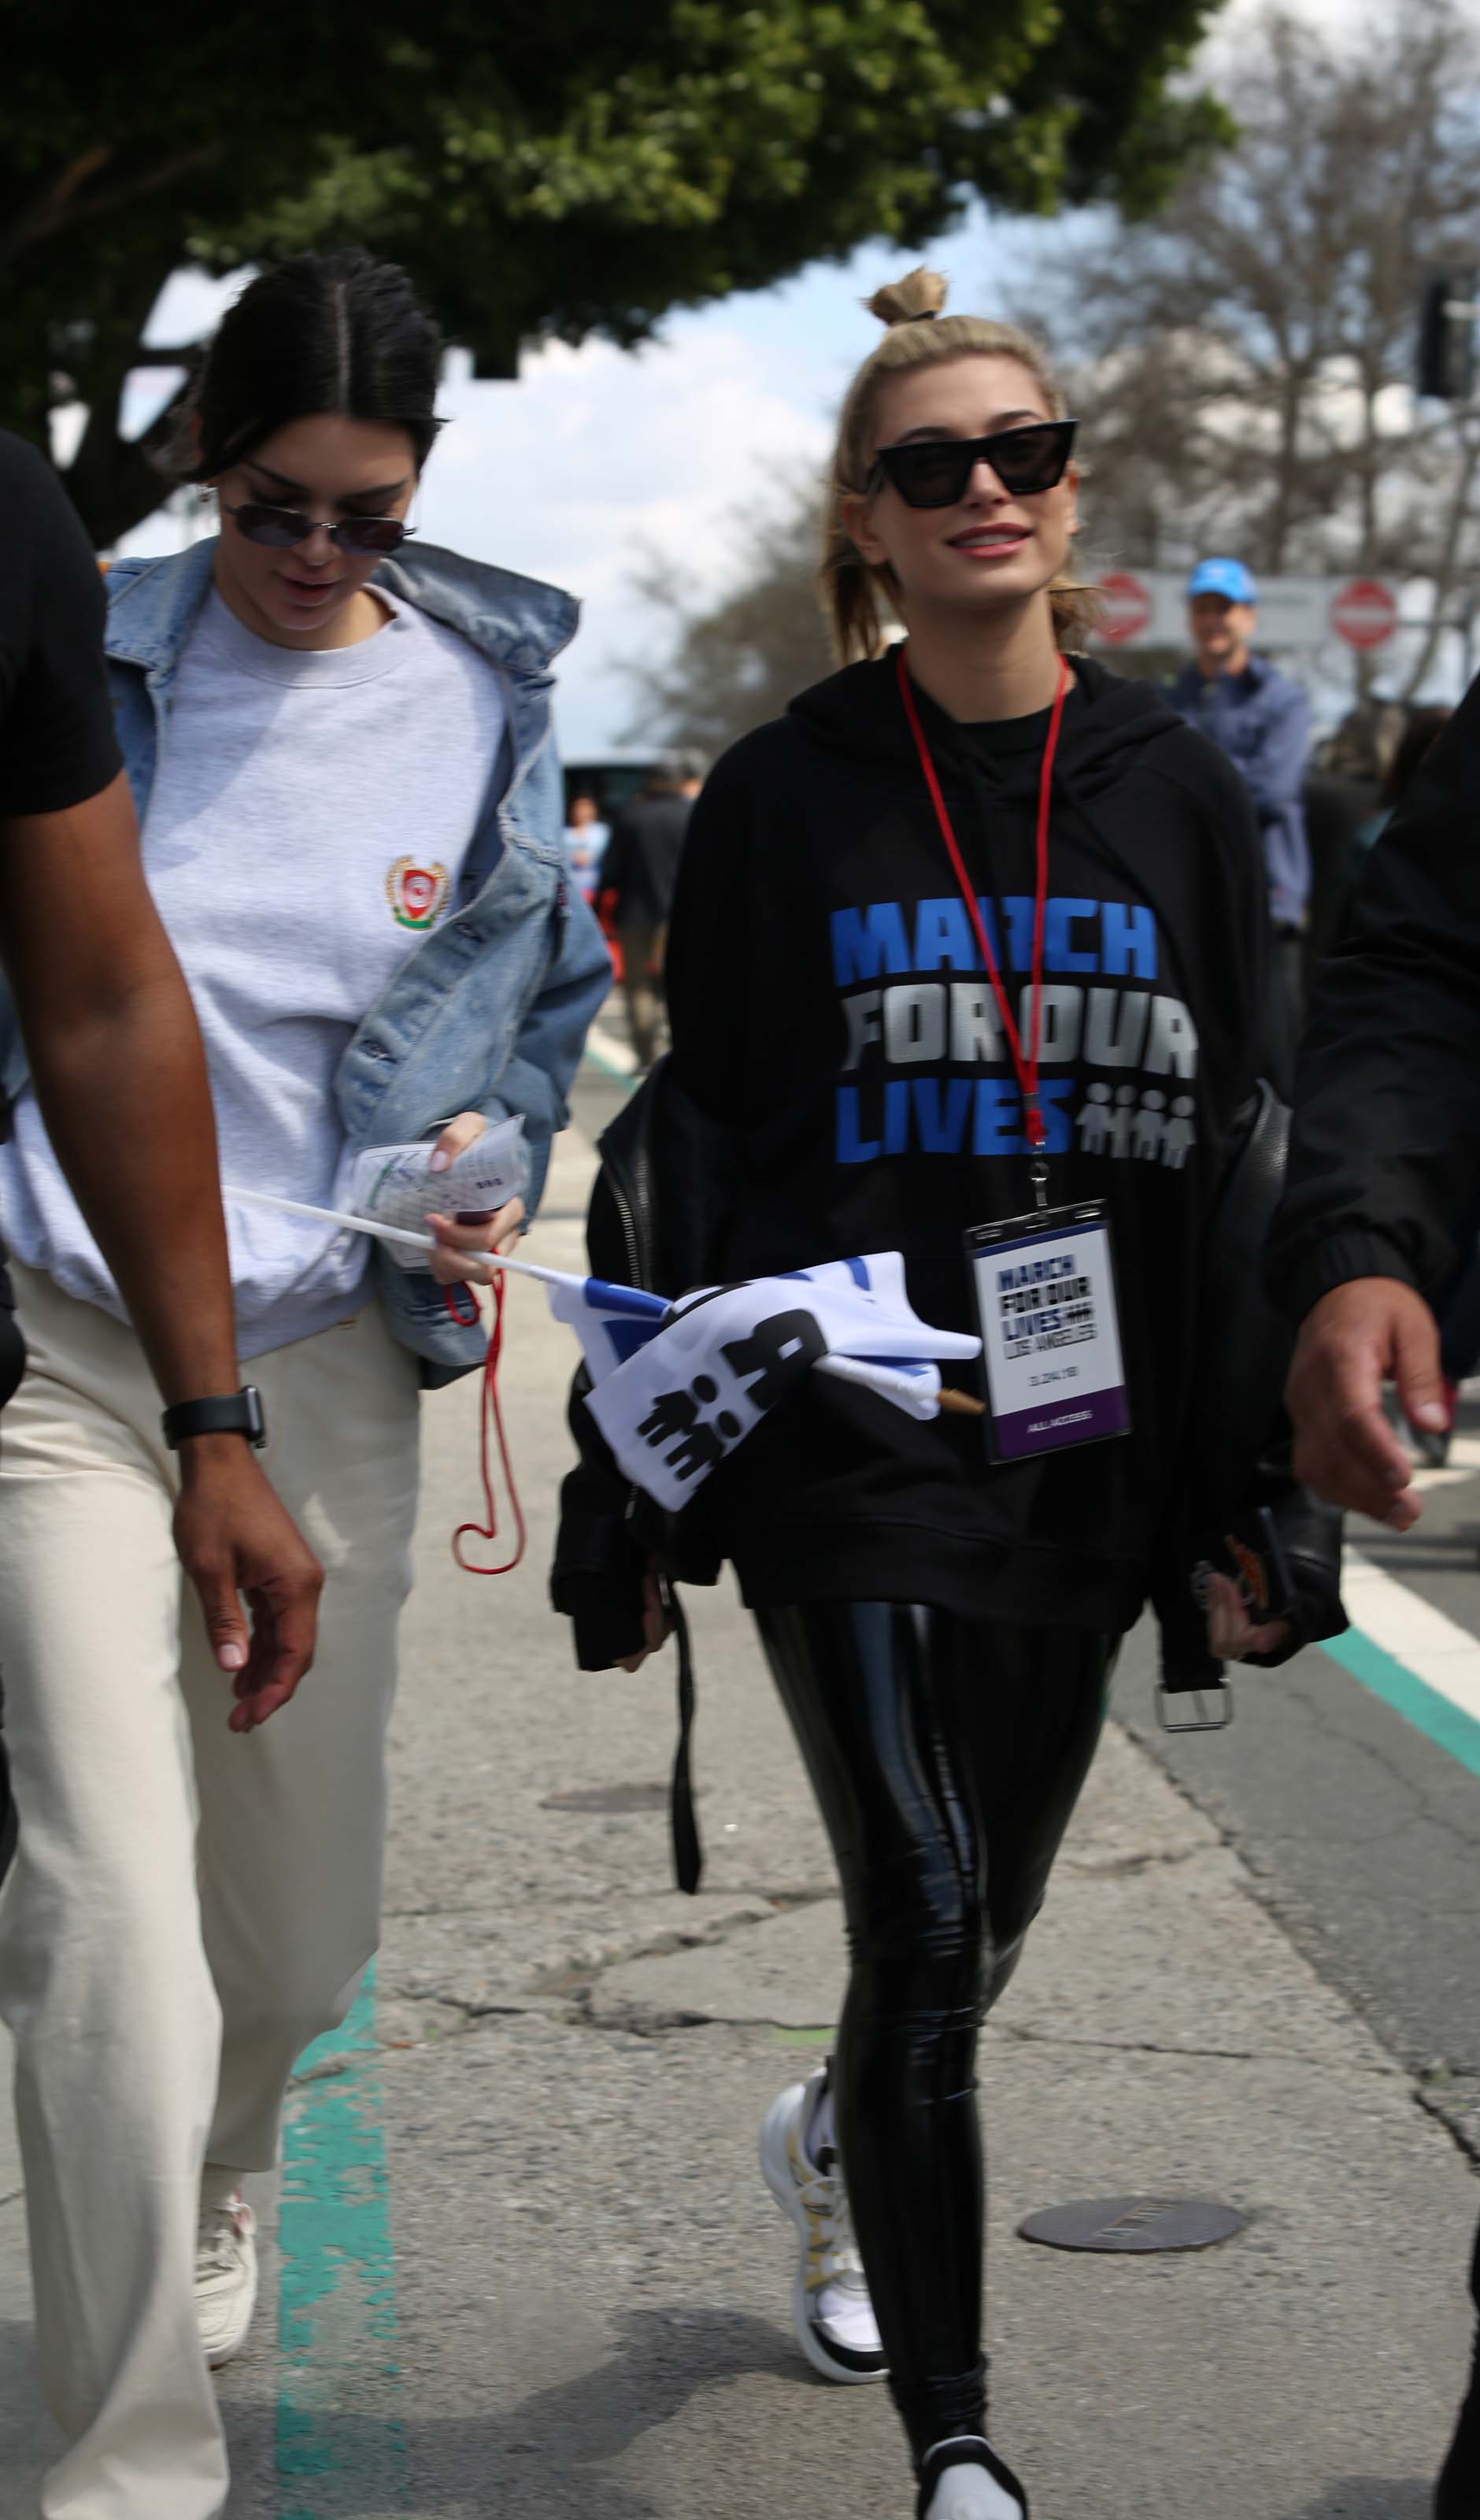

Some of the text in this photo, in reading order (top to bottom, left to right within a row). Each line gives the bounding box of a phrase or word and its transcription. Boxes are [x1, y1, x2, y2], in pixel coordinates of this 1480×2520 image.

[831, 895, 1158, 988] MARCH
[840, 983, 1198, 1079] FOR OUR
[835, 1077, 1076, 1163] LIVES
[997, 1253, 1076, 1292] MARCH
[999, 1275, 1092, 1317] FOR OUR
[1001, 1307, 1061, 1343] LIVES
